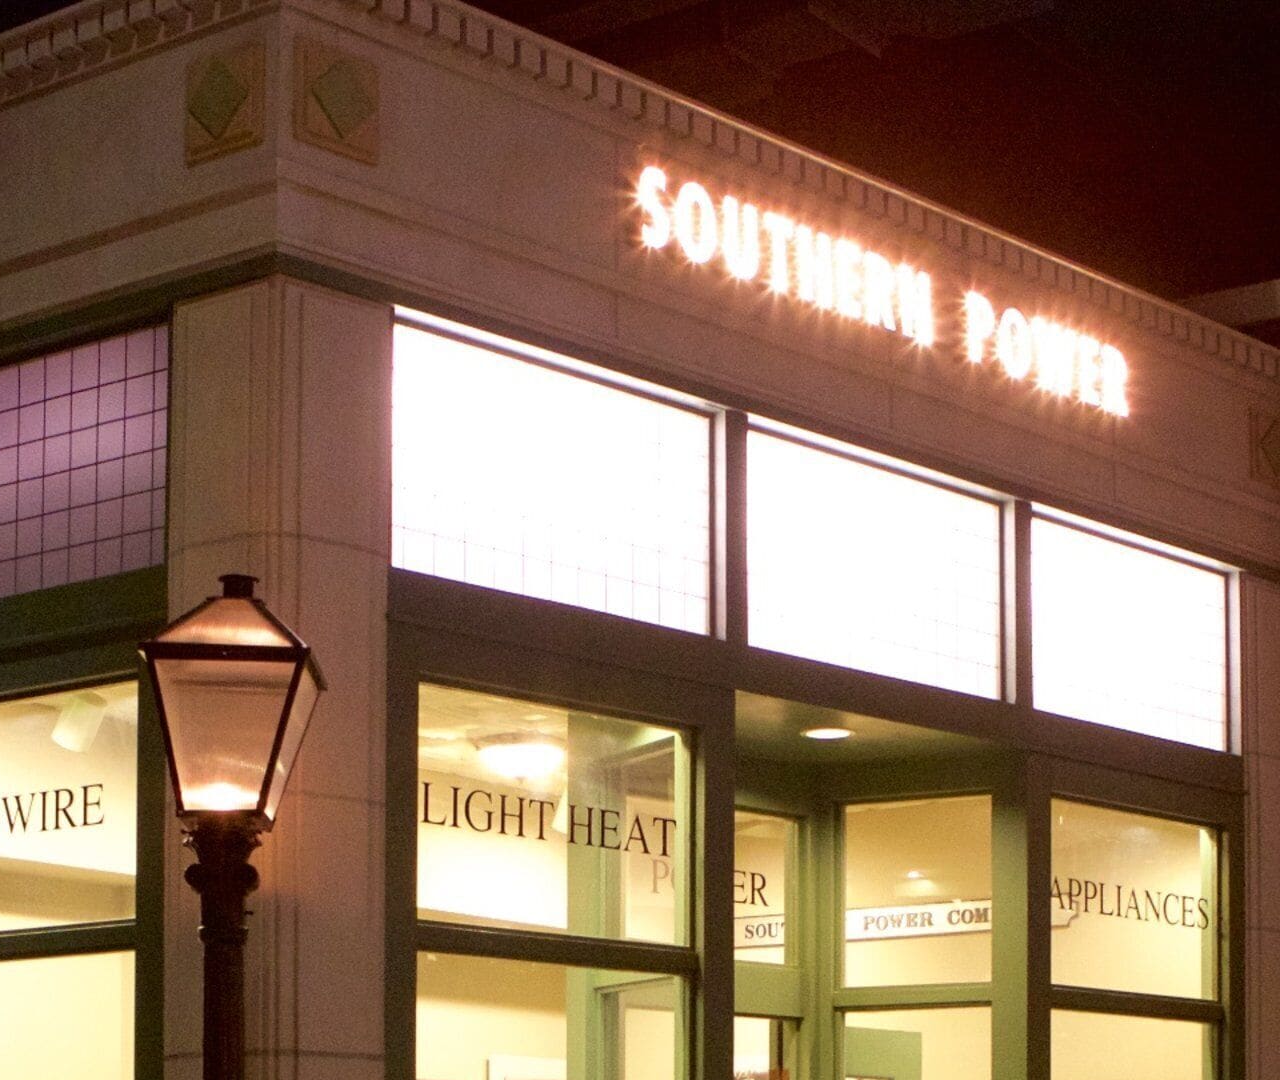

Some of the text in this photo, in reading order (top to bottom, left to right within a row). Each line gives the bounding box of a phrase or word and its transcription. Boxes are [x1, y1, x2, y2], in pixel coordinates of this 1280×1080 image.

[637, 165, 1130, 418] SOUTHERN POWER
[2, 783, 105, 834] WIRE
[421, 782, 677, 857] LIGHT HEAT
[863, 911, 934, 931] POWER
[1051, 876, 1210, 930] APPLIANCES
